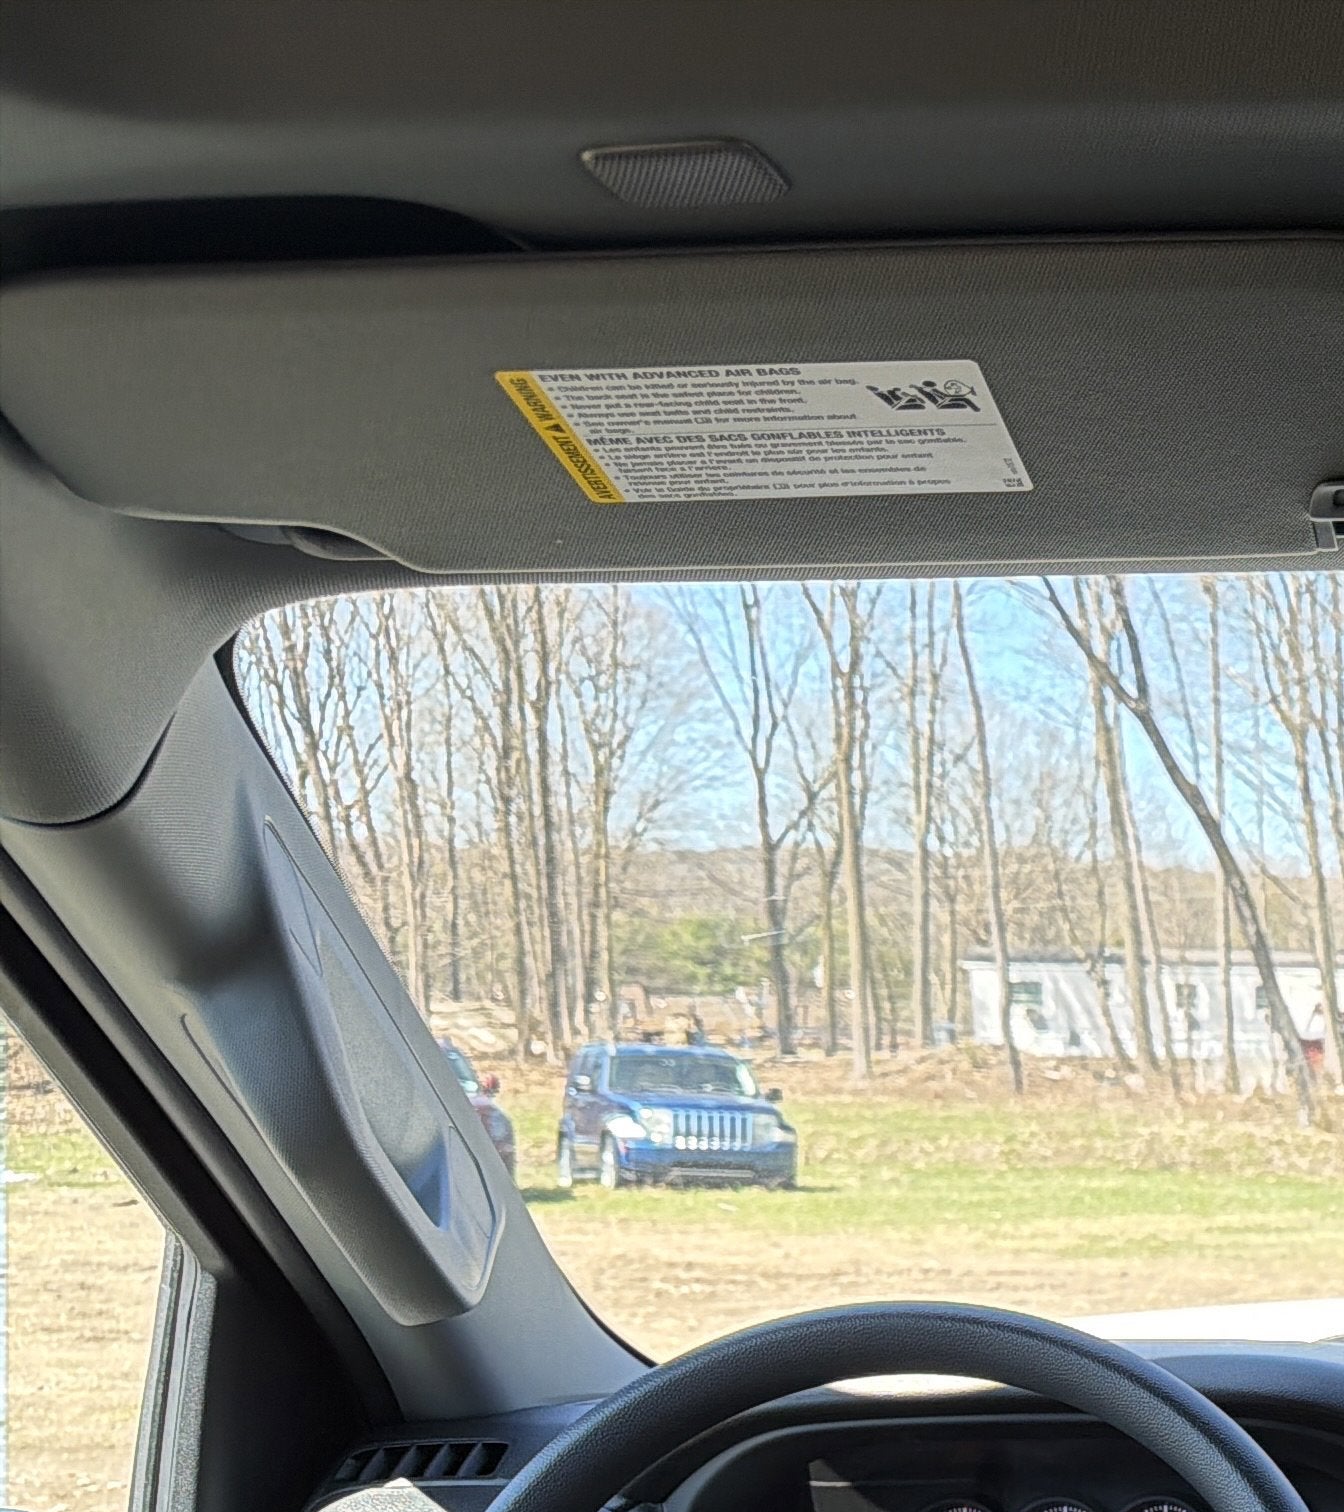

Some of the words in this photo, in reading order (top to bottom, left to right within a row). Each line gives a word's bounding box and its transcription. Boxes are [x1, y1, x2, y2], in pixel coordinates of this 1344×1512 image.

[538, 374, 582, 382] EVEN
[584, 372, 626, 382] WITH
[632, 369, 720, 380] ADVANCED
[725, 368, 753, 378] AIR
[755, 367, 802, 377] BAGS
[509, 377, 556, 422] WARNING
[636, 435, 674, 445] AVEC
[676, 434, 705, 444] DES
[708, 433, 748, 443] SACS
[846, 428, 946, 438] INTELLIGENTS
[552, 436, 617, 501] AVERTISSEMENT
